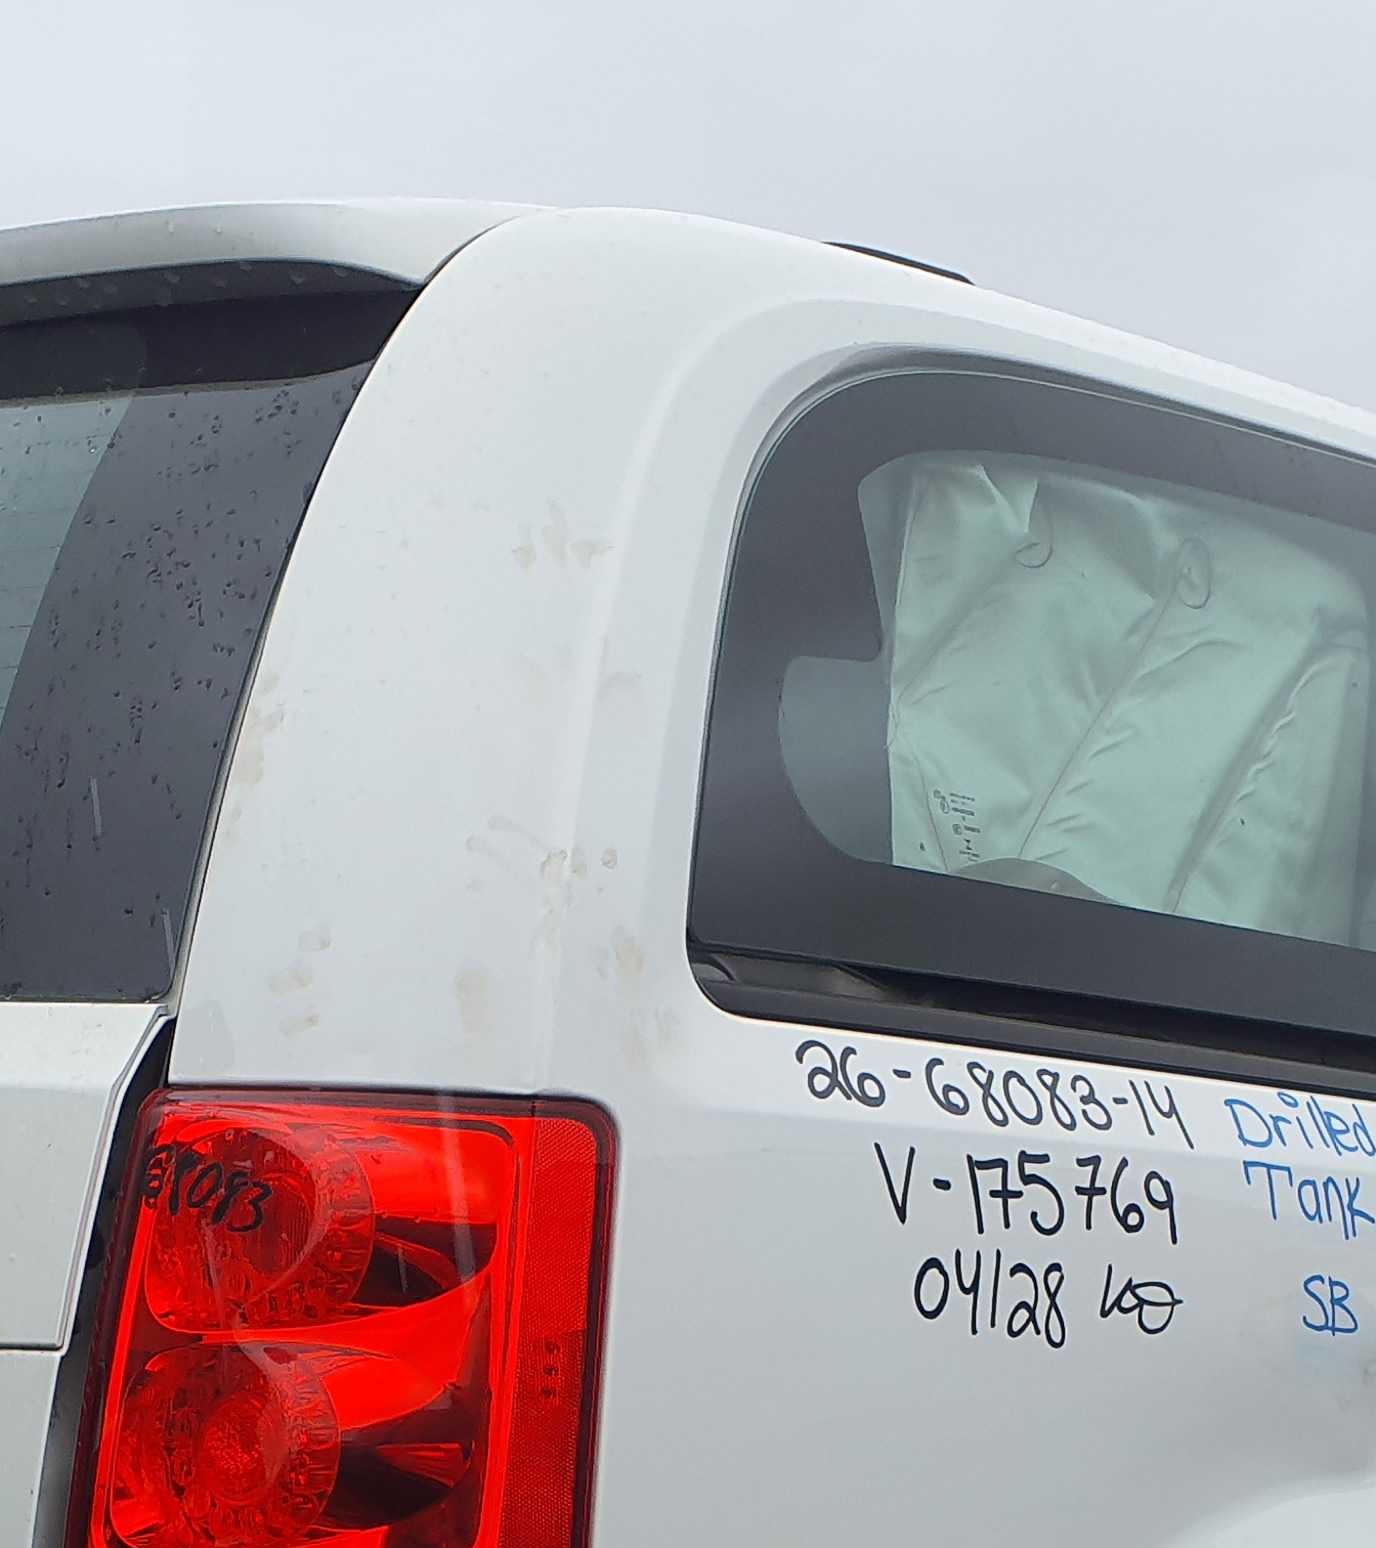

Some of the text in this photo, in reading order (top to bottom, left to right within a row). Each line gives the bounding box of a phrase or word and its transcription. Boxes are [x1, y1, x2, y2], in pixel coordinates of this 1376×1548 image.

[795, 1039, 1195, 1150] 26-68083-14
[1224, 1092, 1376, 1157] Drilled
[874, 1141, 1178, 1245] V-175769
[1243, 1160, 1376, 1241] Tank
